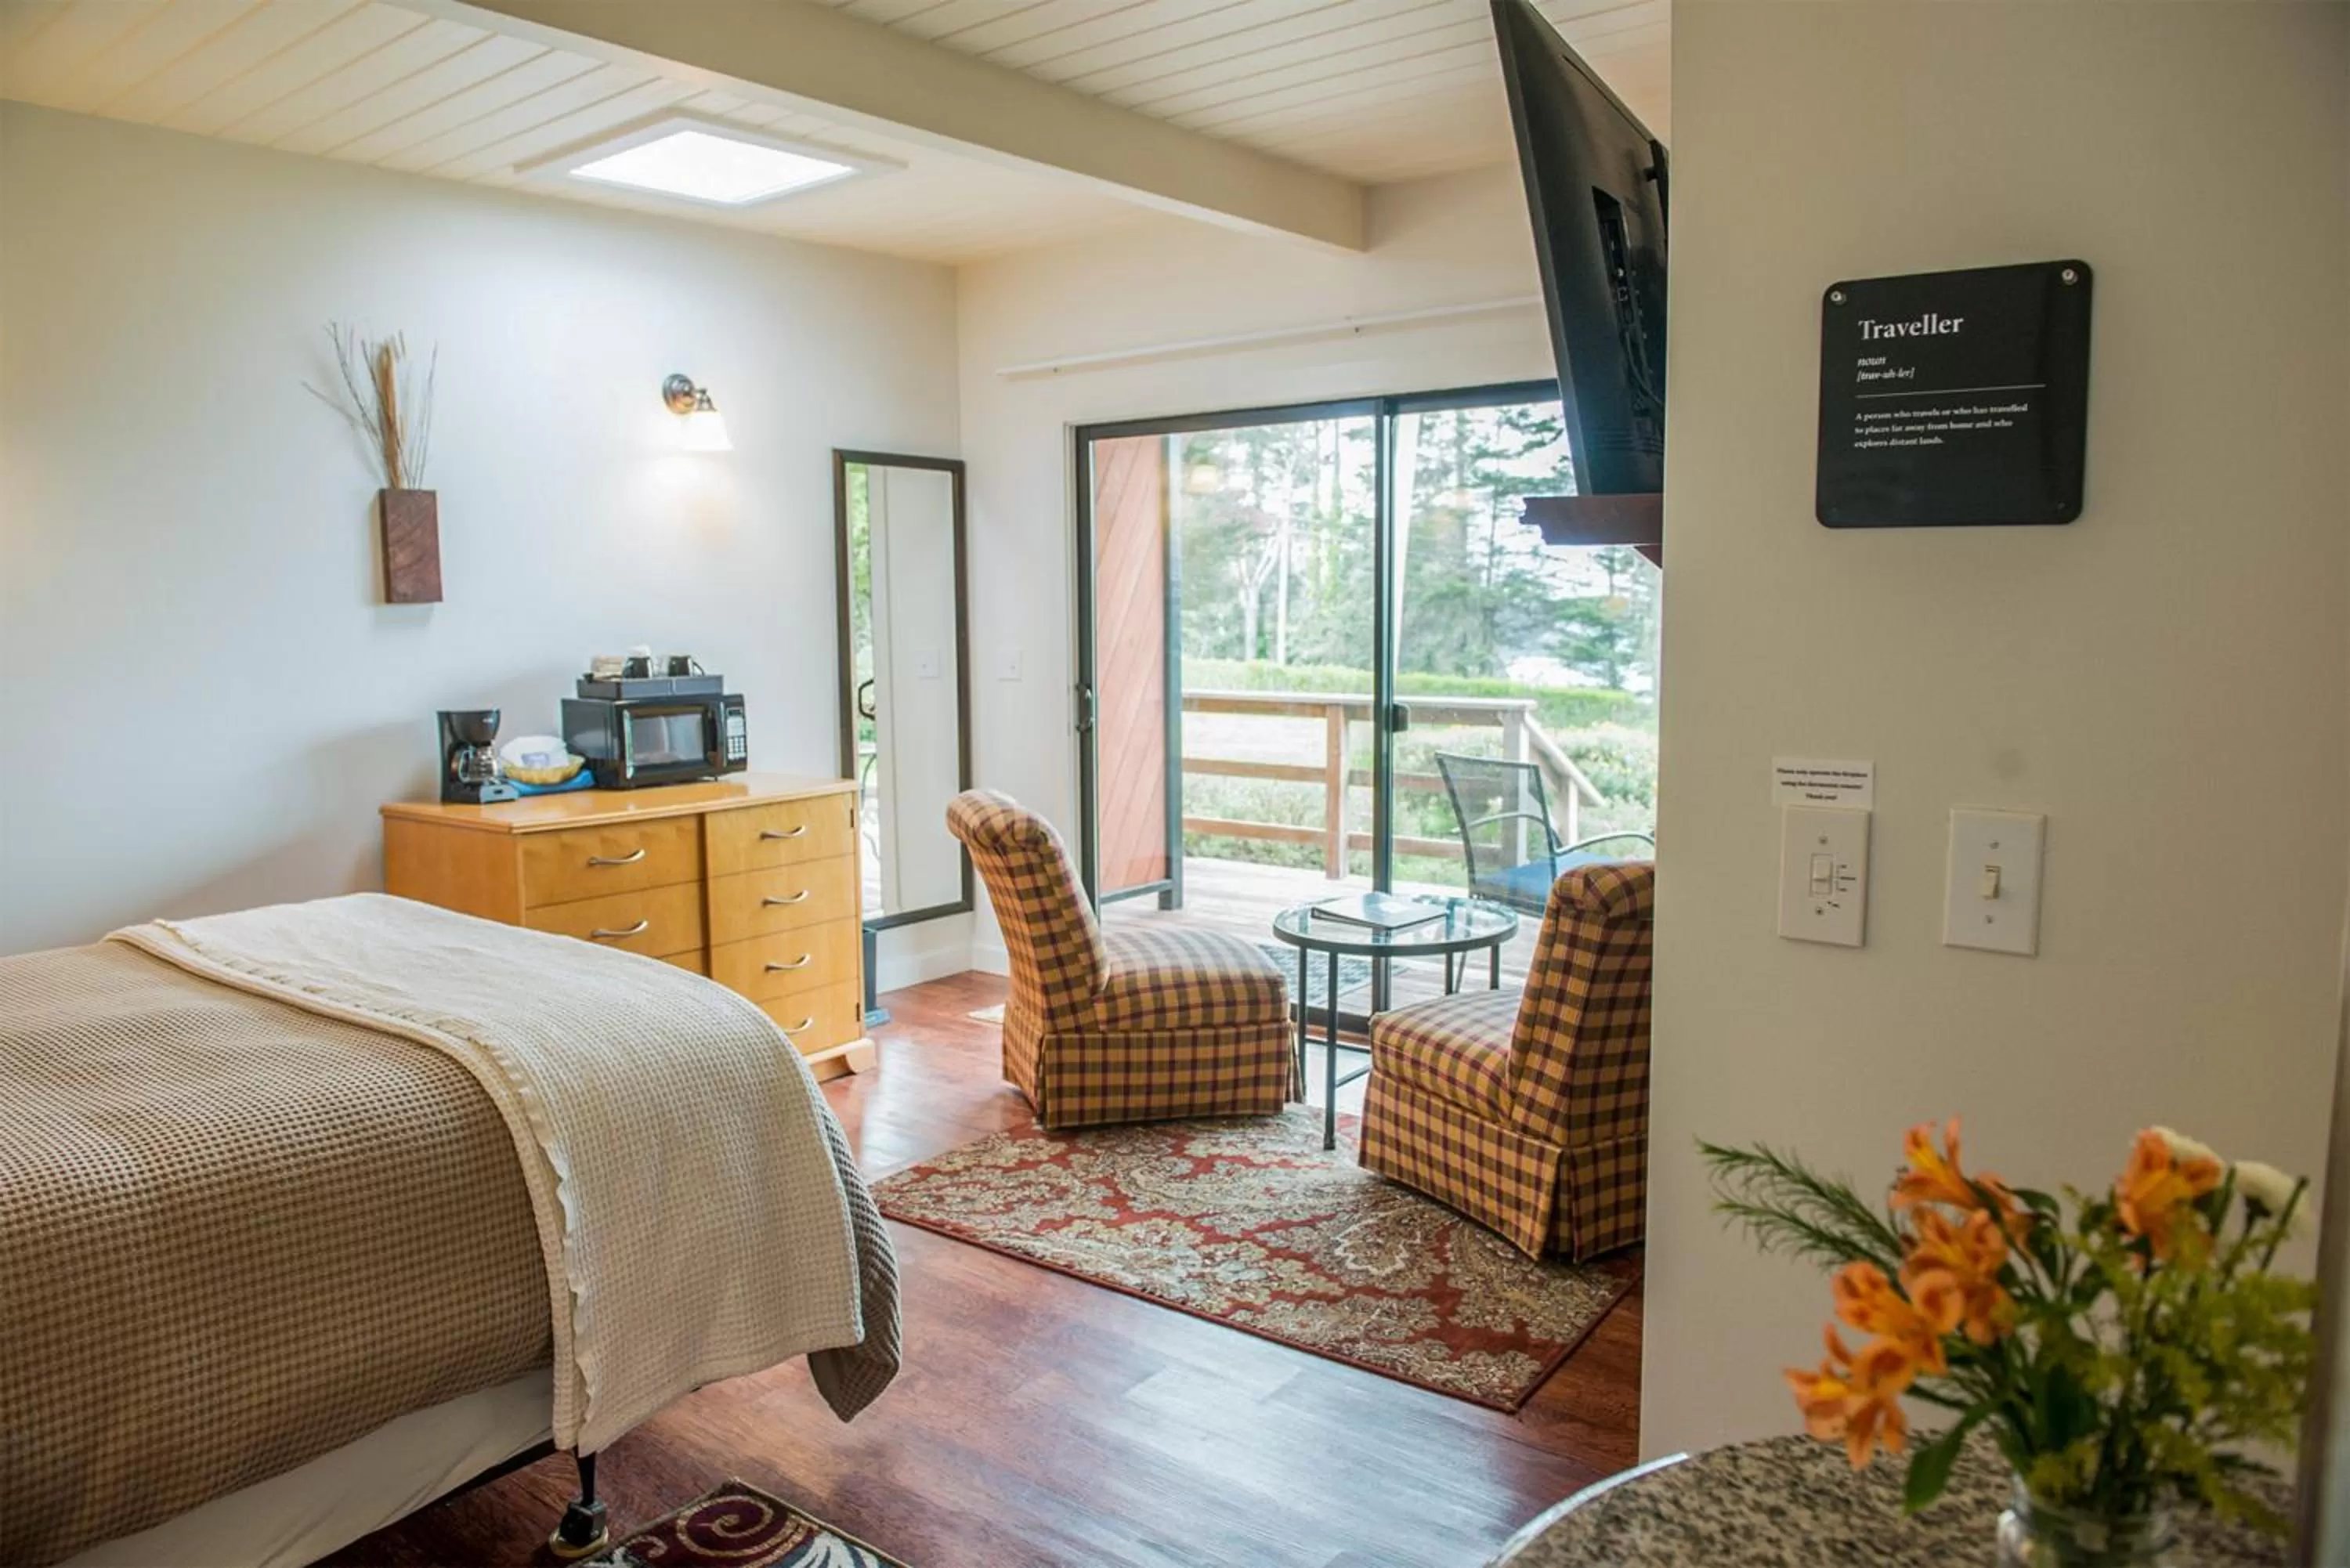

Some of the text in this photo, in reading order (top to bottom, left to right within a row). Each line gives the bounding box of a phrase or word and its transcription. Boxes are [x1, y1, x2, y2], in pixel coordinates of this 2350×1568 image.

[1858, 313, 1964, 340] Traveller
[1857, 356, 1886, 367] noun
[1863, 413, 1892, 421] person
[1893, 409, 1911, 417] who
[1972, 405, 1988, 414] has
[1854, 426, 1864, 435] to
[1864, 425, 1890, 435] places
[1891, 424, 1903, 432] far
[1975, 419, 1992, 428] and
[1993, 417, 2013, 426] who
[1889, 437, 1918, 446] distant
